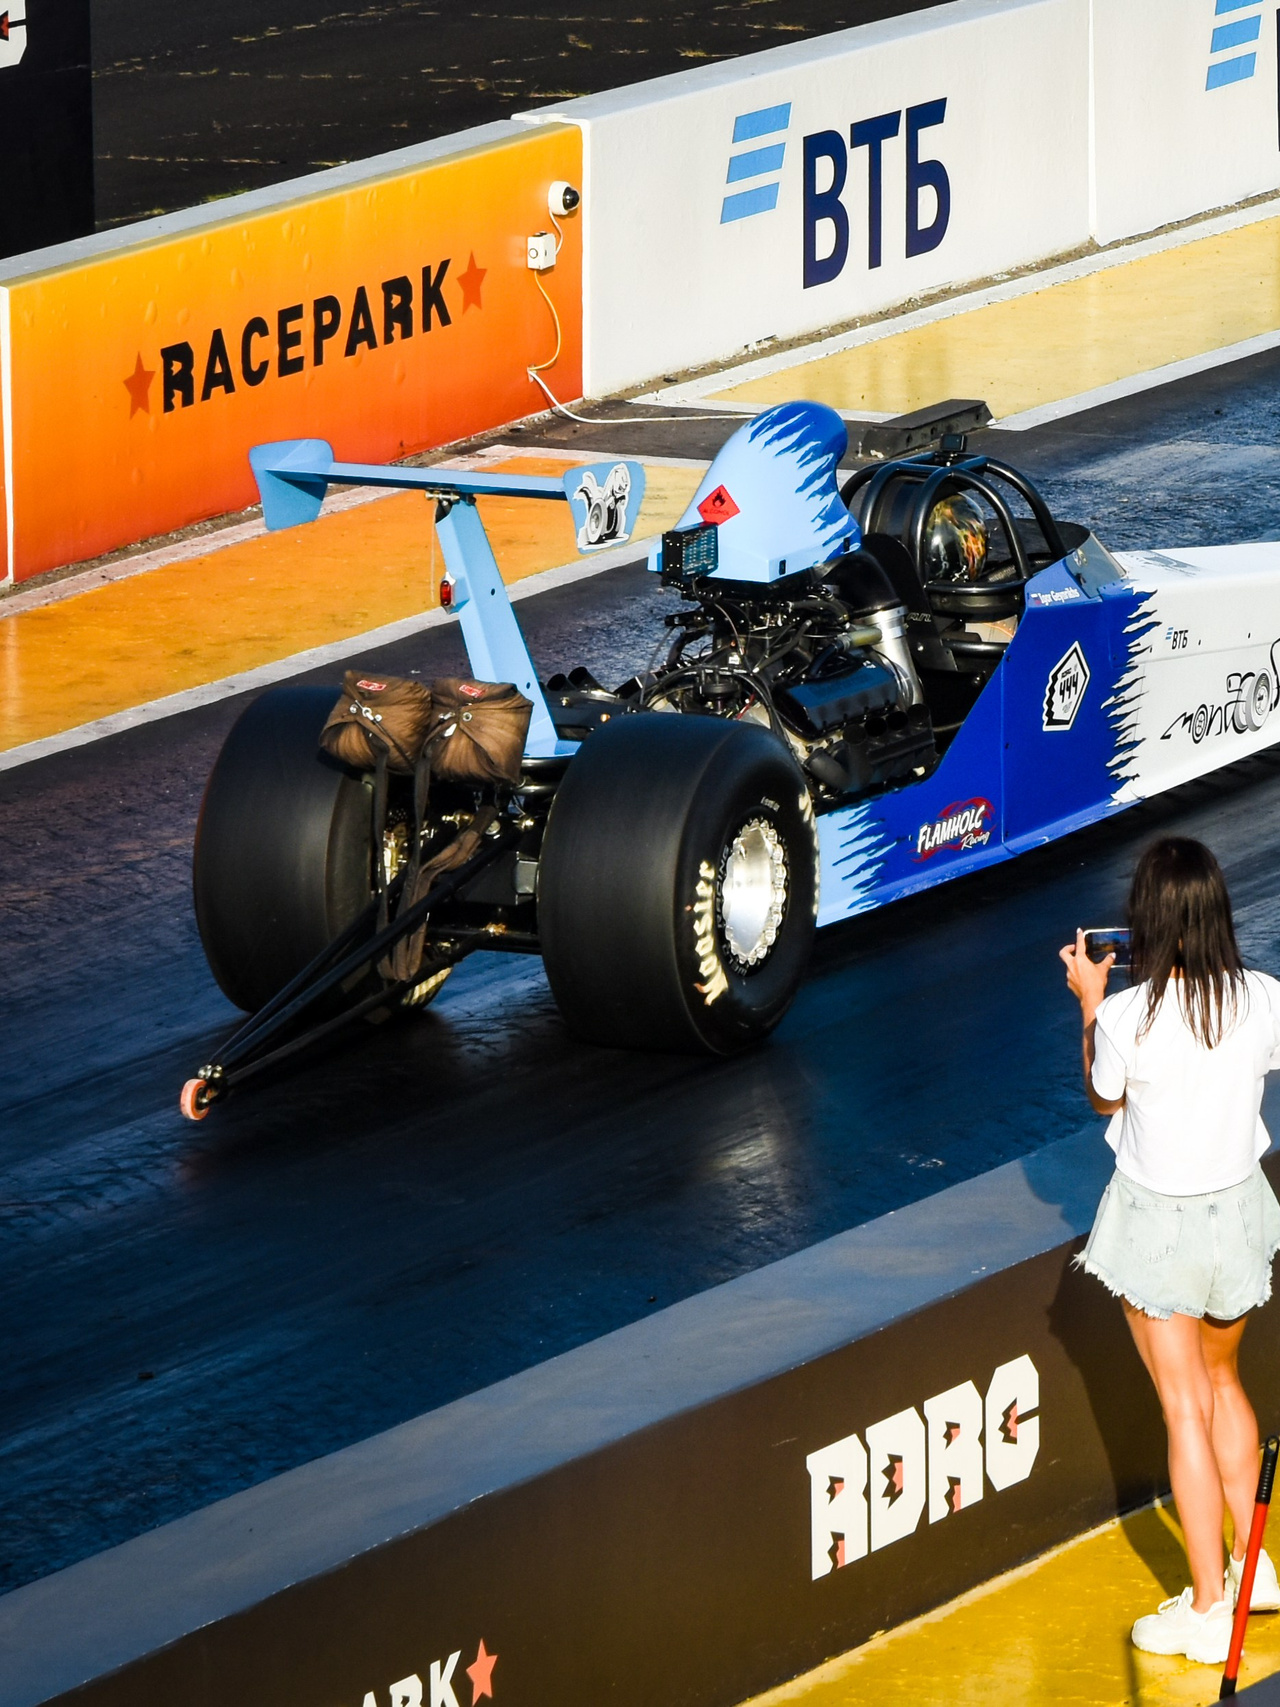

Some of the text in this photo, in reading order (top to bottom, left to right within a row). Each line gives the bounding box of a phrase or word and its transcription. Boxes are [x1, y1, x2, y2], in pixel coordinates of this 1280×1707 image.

[803, 97, 950, 289] ВТБ
[161, 258, 452, 414] RACEPARK
[1059, 671, 1079, 703] 444
[1172, 630, 1188, 650] ВТБ
[806, 1354, 1040, 1581] RDRC
